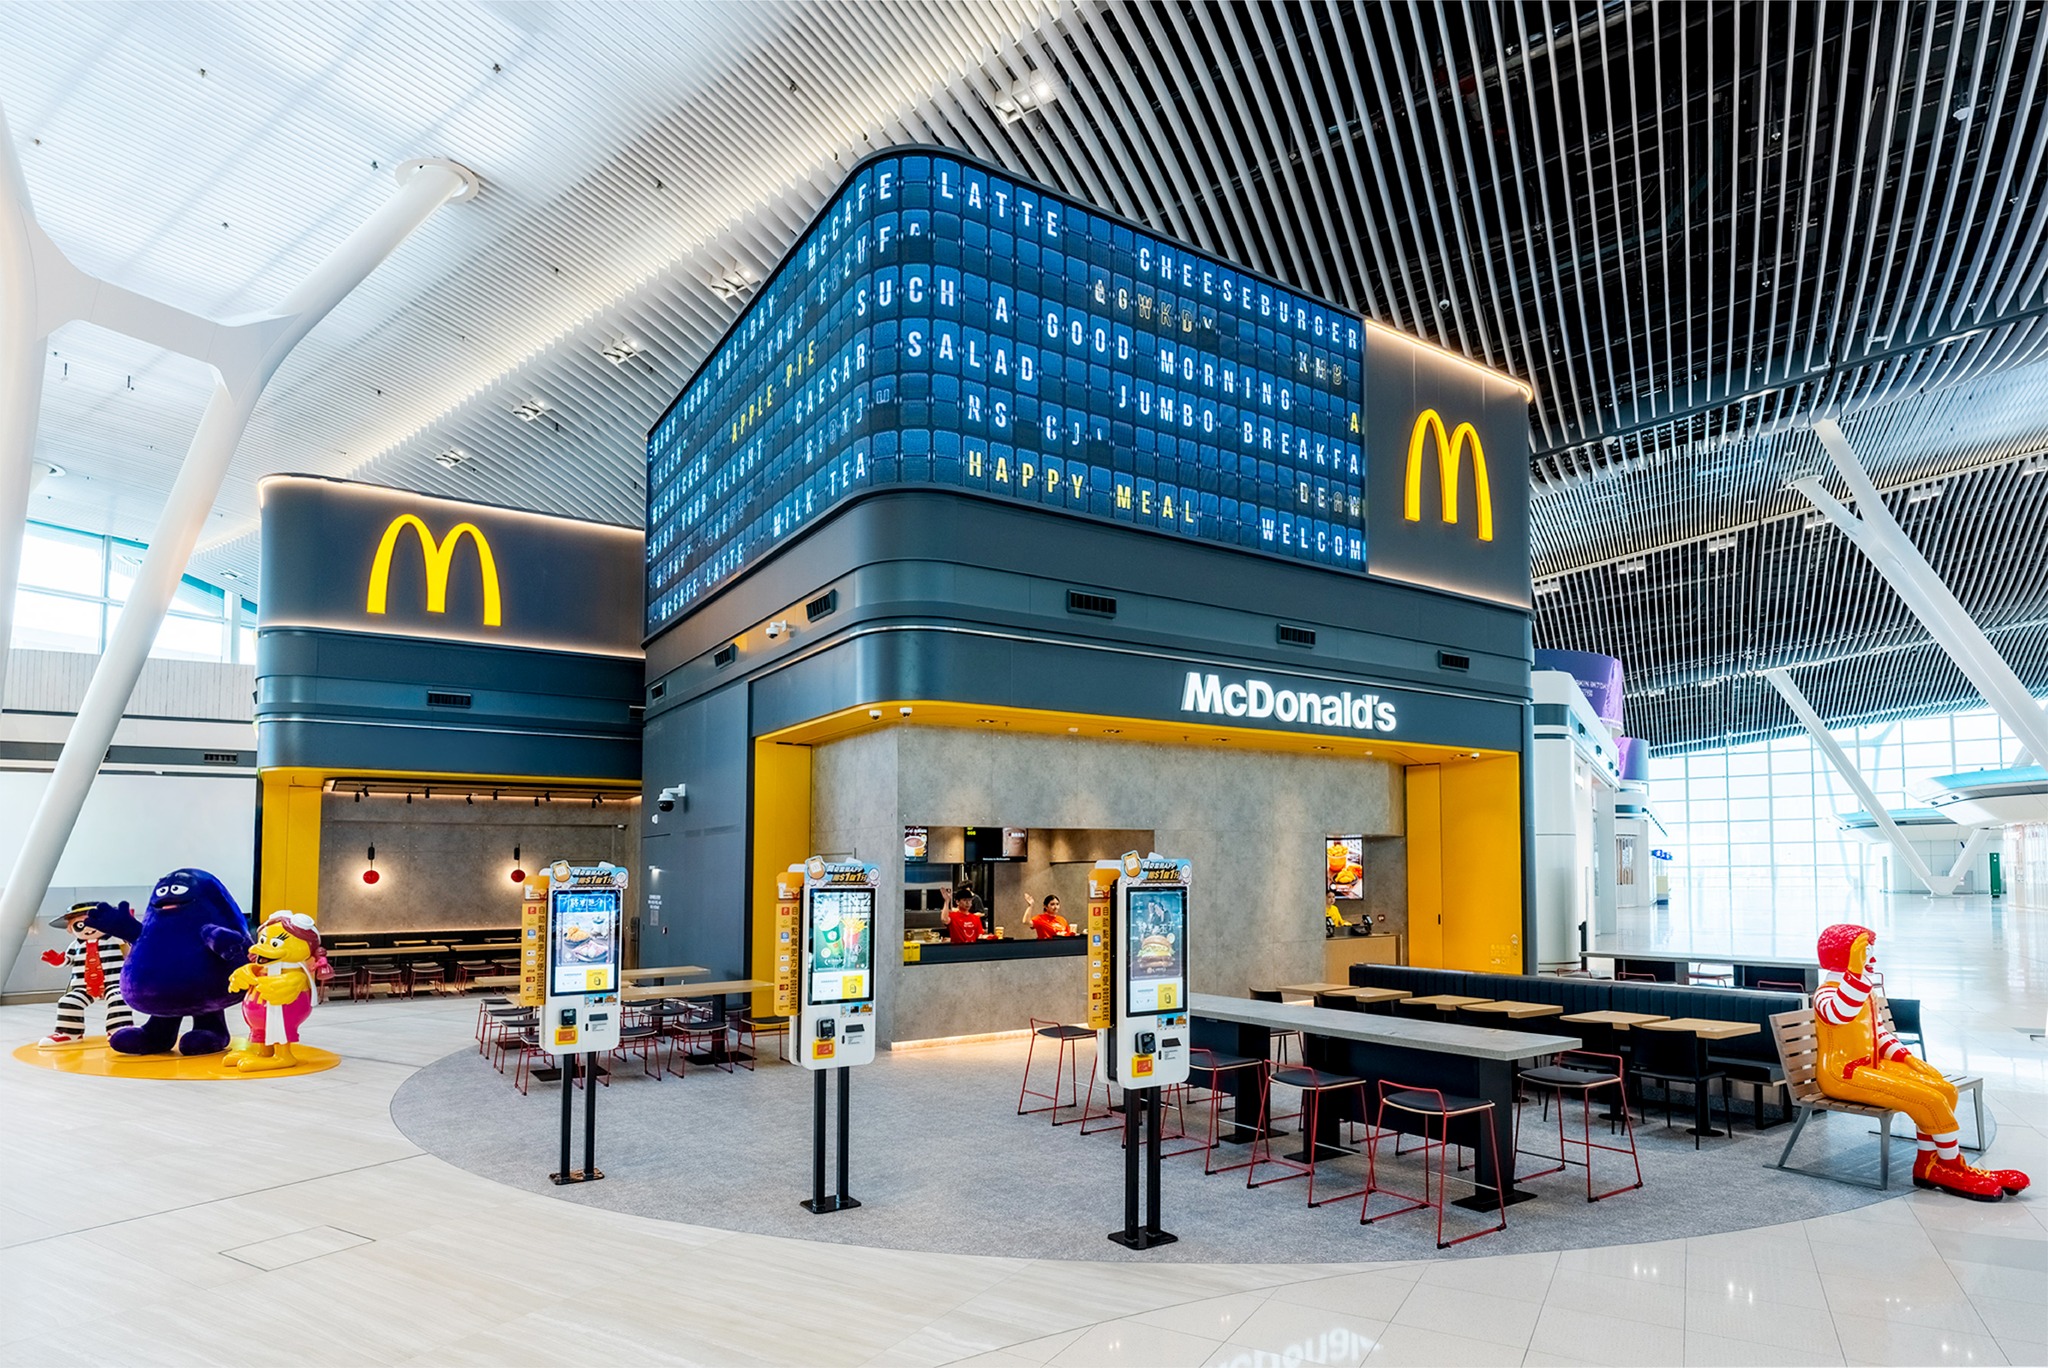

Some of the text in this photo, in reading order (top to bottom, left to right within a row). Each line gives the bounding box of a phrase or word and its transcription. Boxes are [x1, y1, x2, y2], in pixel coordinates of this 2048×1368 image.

[941, 172, 1058, 238] LATTE
[718, 294, 774, 380] HOLIDAY
[1140, 247, 1357, 350] CHEESEBURGER
[795, 330, 1034, 425] CAESAR SALAD
[857, 276, 1290, 411] SUCH A GOOD MORNING
[731, 340, 815, 444] APPLE PIE
[1118, 385, 1359, 475] JUMBO BREAKFA
[716, 438, 763, 500] FLIGHT
[773, 488, 813, 538] MILK
[829, 452, 866, 497] TEA
[968, 449, 1194, 524] HAPPY MEAL
[706, 542, 743, 588] LATTE
[1181, 671, 1397, 732] McDonald's
